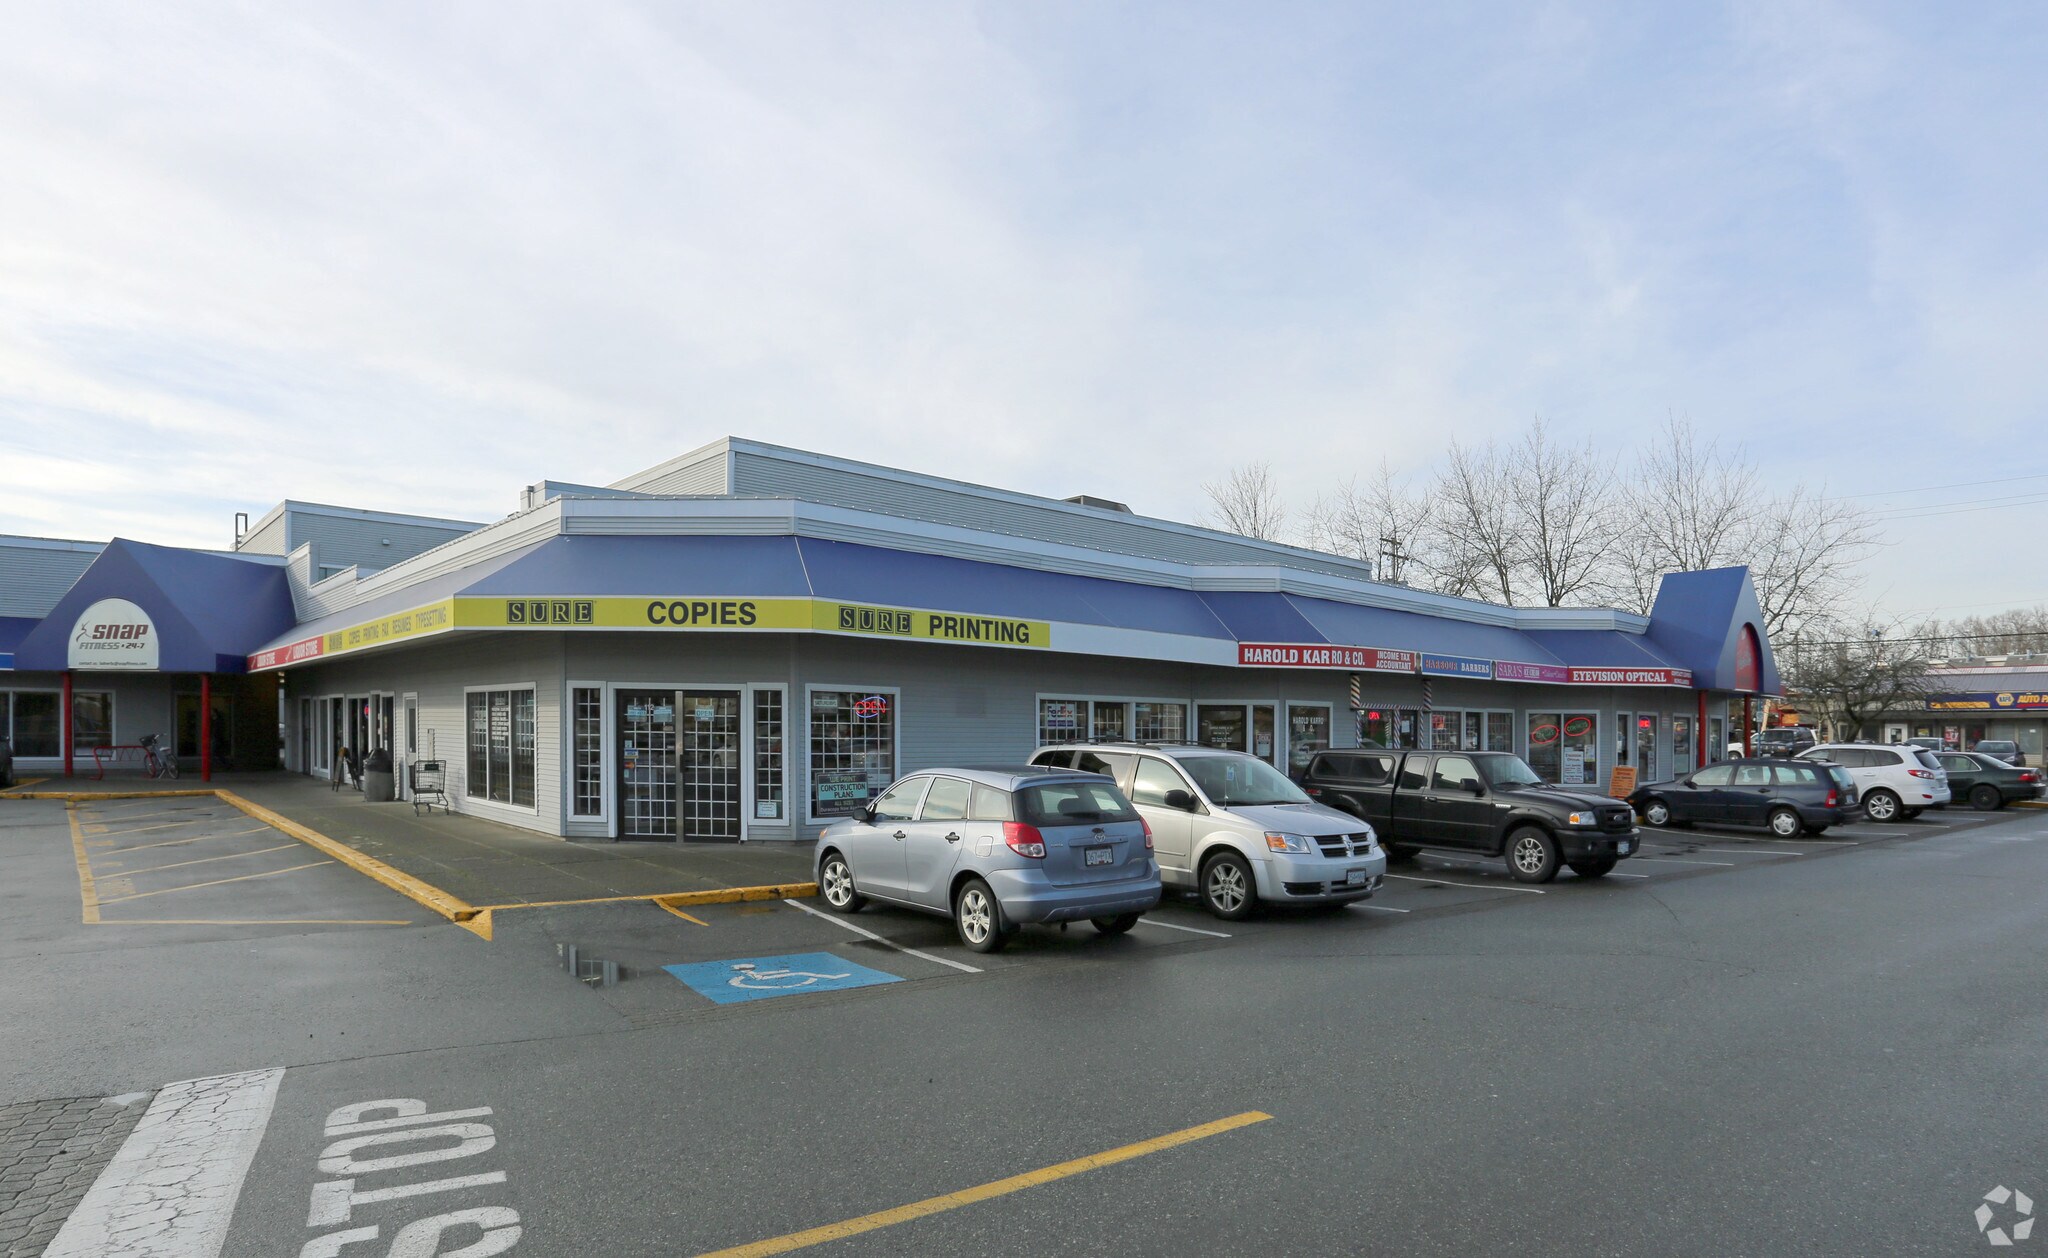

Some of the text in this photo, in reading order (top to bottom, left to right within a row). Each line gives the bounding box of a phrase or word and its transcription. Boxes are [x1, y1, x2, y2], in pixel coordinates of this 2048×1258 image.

[508, 601, 757, 625] SURE COPIES
[393, 616, 411, 634] RESUMES
[416, 606, 447, 629] TYPESETTING
[840, 607, 1030, 644] SURE PRINTING
[79, 642, 121, 650] FITNESS
[306, 640, 318, 656] STORE
[1244, 648, 1366, 666] HAROLD KARRO & CO.
[1377, 650, 1411, 661] INCOME TAX
[1376, 660, 1411, 671] ACCOUNTANT
[1425, 659, 1489, 673] HARBOUR BARBERS
[1499, 664, 1522, 677] SARA'S
[1573, 671, 1624, 682] EYEVISION
[1626, 672, 1667, 682] OPTICAL
[2017, 695, 2040, 703] AUTO
[855, 701, 887, 714] OPEN
[820, 783, 866, 792] CONSTRUCTION
